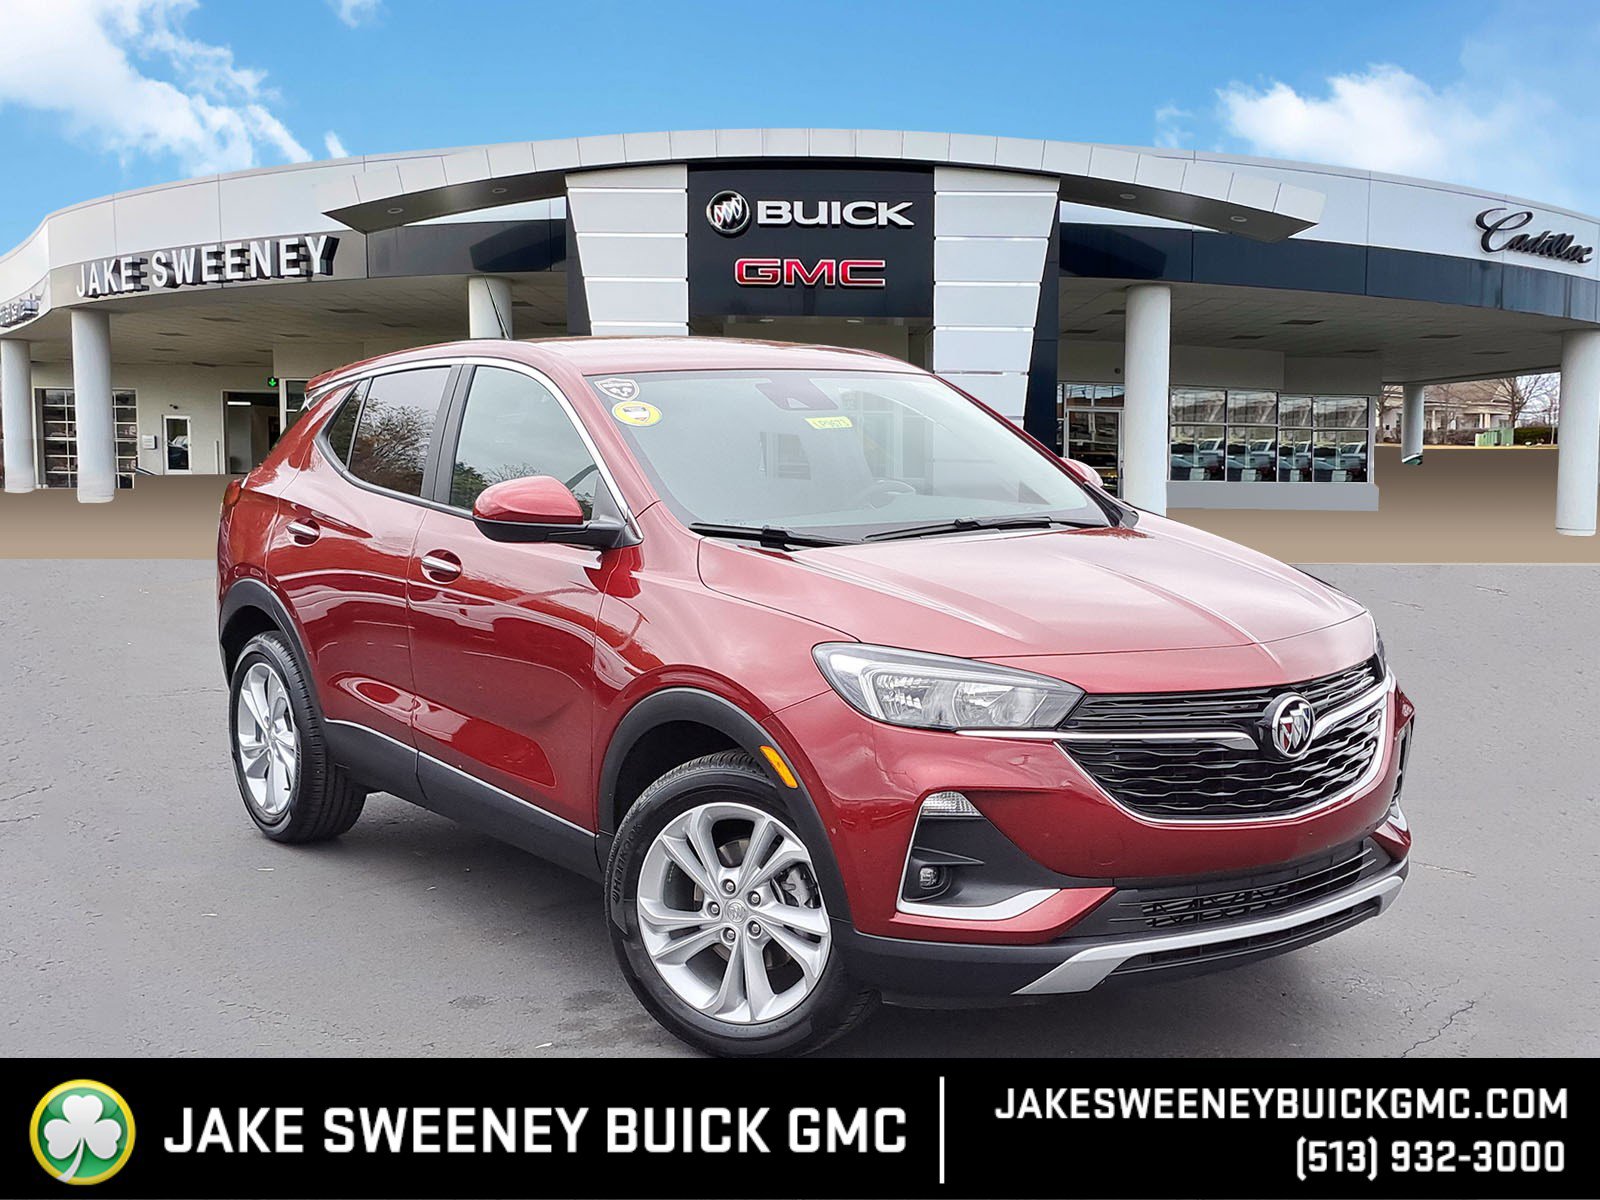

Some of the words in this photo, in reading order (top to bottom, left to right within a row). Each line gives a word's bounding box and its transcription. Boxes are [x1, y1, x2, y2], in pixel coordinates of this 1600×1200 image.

[756, 200, 915, 226] BUICK
[1475, 207, 1593, 264] Cadillac
[76, 256, 141, 298] JAKE
[151, 235, 334, 289] SWEENEY
[735, 258, 886, 287] GMC
